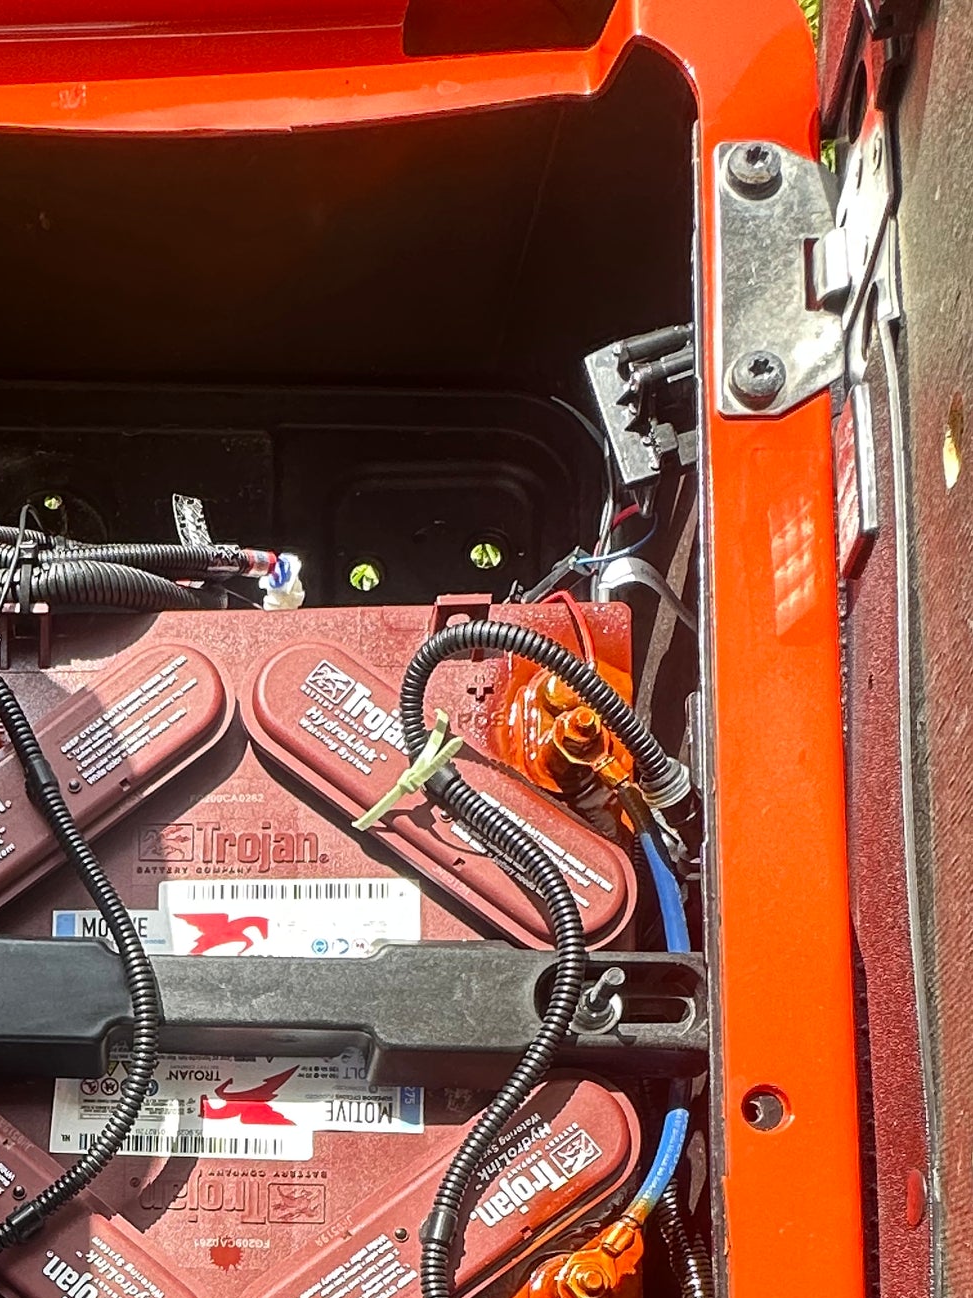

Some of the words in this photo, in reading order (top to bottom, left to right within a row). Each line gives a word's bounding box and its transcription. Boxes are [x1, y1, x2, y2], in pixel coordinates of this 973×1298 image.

[299, 718, 339, 751] Watering
[337, 746, 371, 774] System
[305, 706, 378, 762] HydroLink
[137, 866, 188, 874] BATTERY
[196, 866, 252, 874] COMPANY
[197, 822, 319, 872] Trojan
[169, 1070, 221, 1081] TROJAN
[325, 1101, 393, 1124] MOTIVE
[275, 1170, 328, 1178] BATTERY
[476, 1123, 552, 1182] HydroLink
[140, 1172, 266, 1224] Trojan
[474, 1159, 569, 1228] Trojan
[92, 1236, 125, 1266] System
